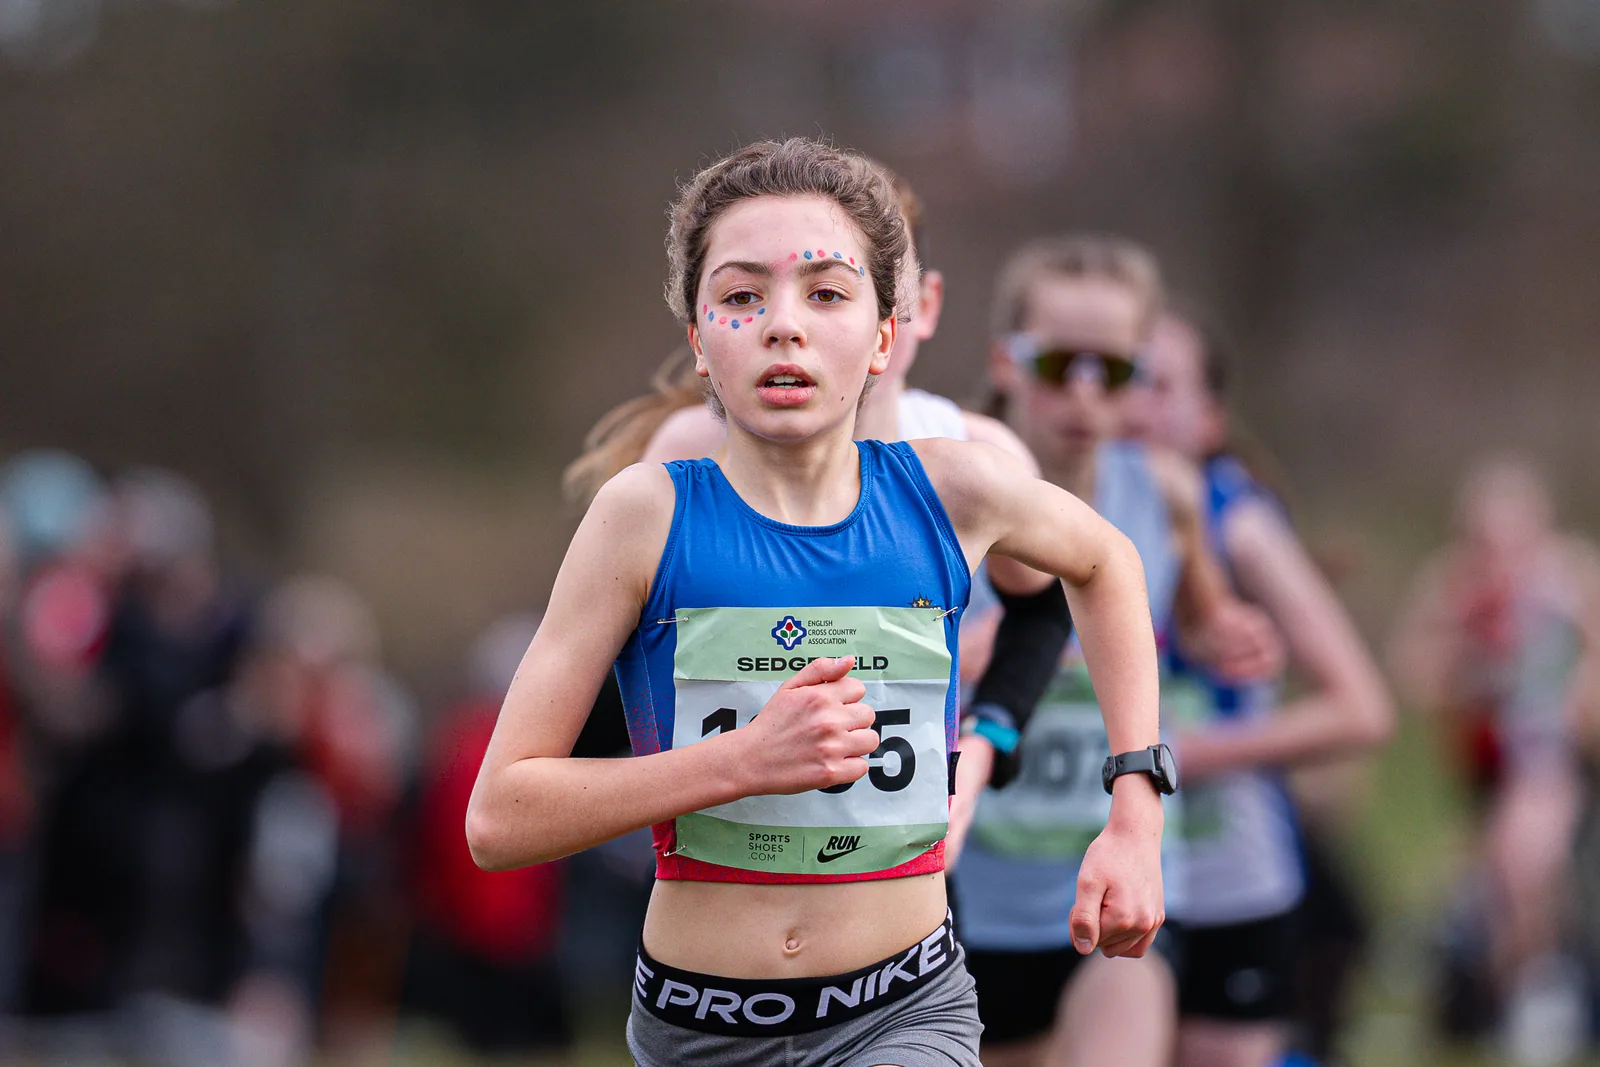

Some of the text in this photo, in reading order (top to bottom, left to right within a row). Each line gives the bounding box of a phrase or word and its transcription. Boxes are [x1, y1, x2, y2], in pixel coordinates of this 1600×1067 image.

[828, 628, 857, 636] COUNTRY
[736, 656, 889, 671] SEDGLD
[748, 833, 791, 843] SPORTS
[826, 835, 861, 850] RUN
[748, 842, 784, 852] SHOES
[748, 852, 776, 862] .COM
[656, 978, 796, 1025] PRO
[816, 924, 947, 1019] NIKE
